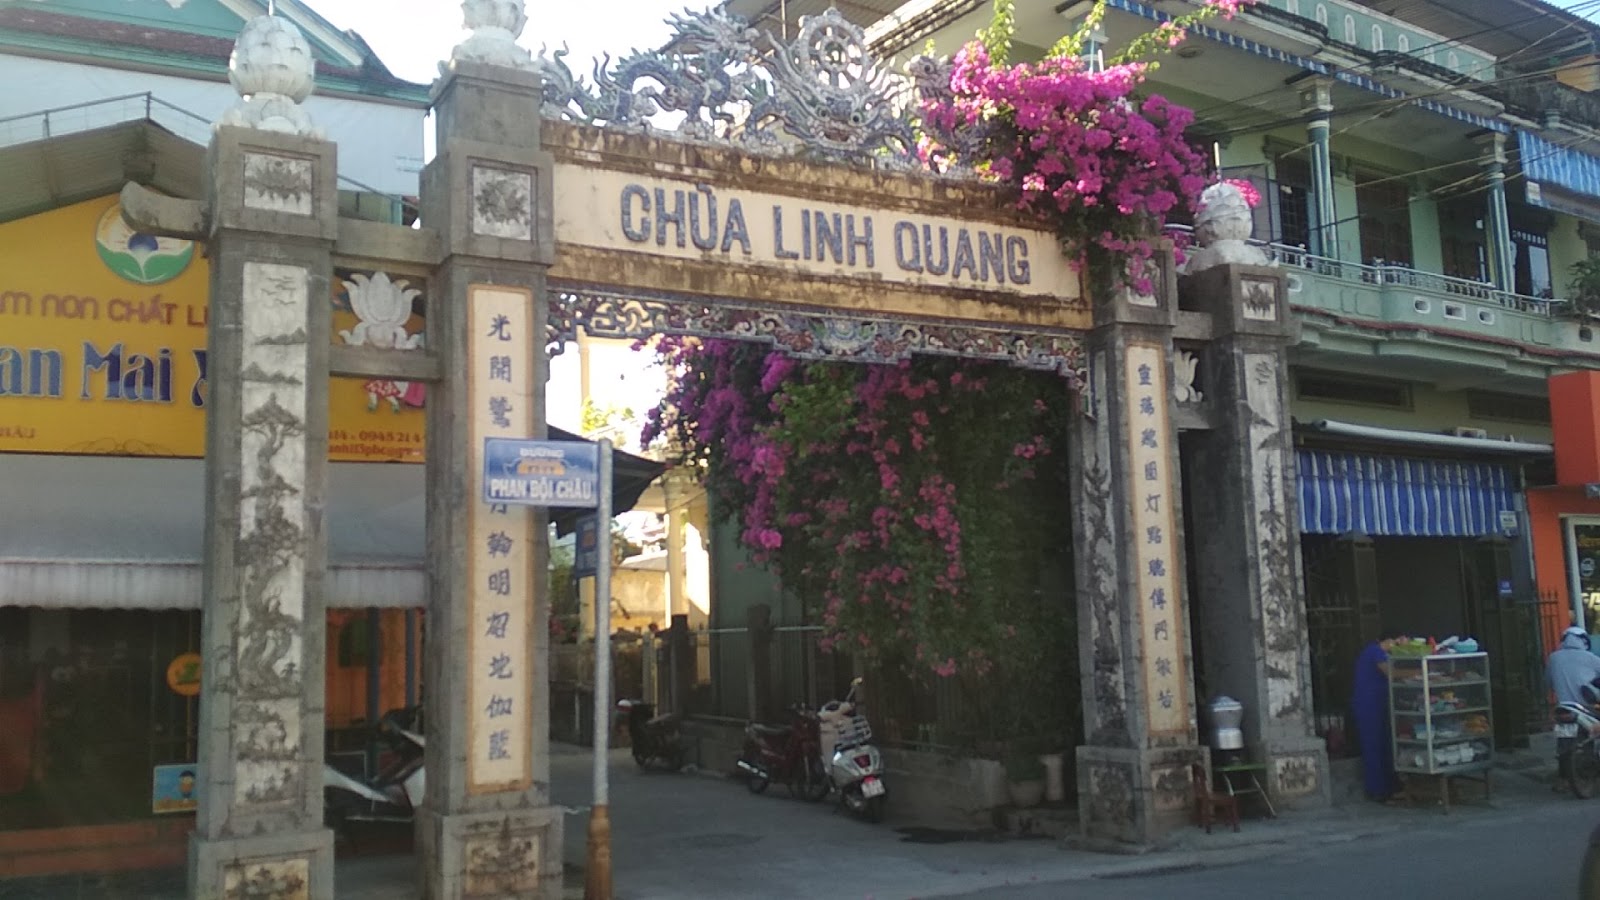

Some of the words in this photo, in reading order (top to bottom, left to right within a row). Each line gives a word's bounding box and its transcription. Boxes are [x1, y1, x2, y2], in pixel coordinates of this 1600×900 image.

[620, 183, 752, 255] CHÙA
[772, 204, 875, 268] LINH
[895, 220, 1031, 285] QUANG
[80, 340, 173, 404] Mai
[491, 479, 528, 499] PHAN
[555, 477, 593, 501] CHÂU
